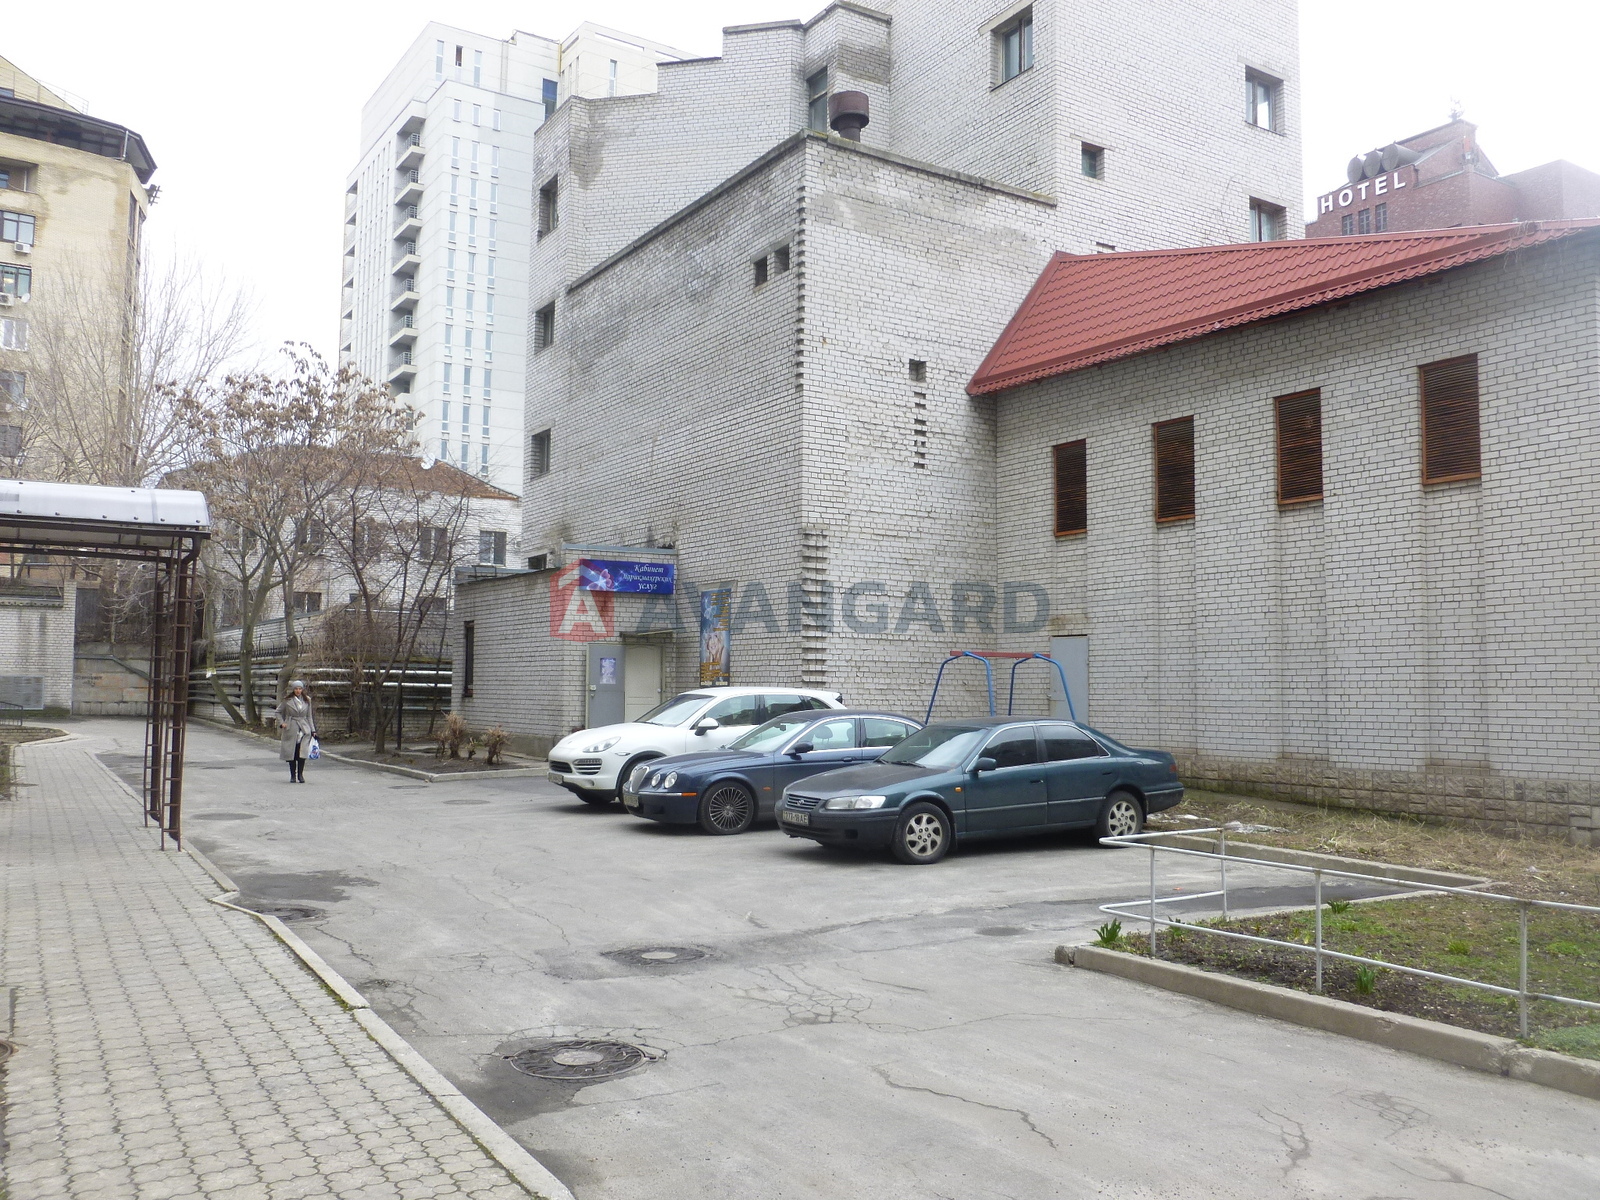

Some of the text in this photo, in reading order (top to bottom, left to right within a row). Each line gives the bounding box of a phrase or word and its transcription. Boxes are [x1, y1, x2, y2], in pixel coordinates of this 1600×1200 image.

[1320, 172, 1406, 214] HOTEL
[634, 564, 664, 574] Кабинет
[636, 583, 657, 592] услуг
